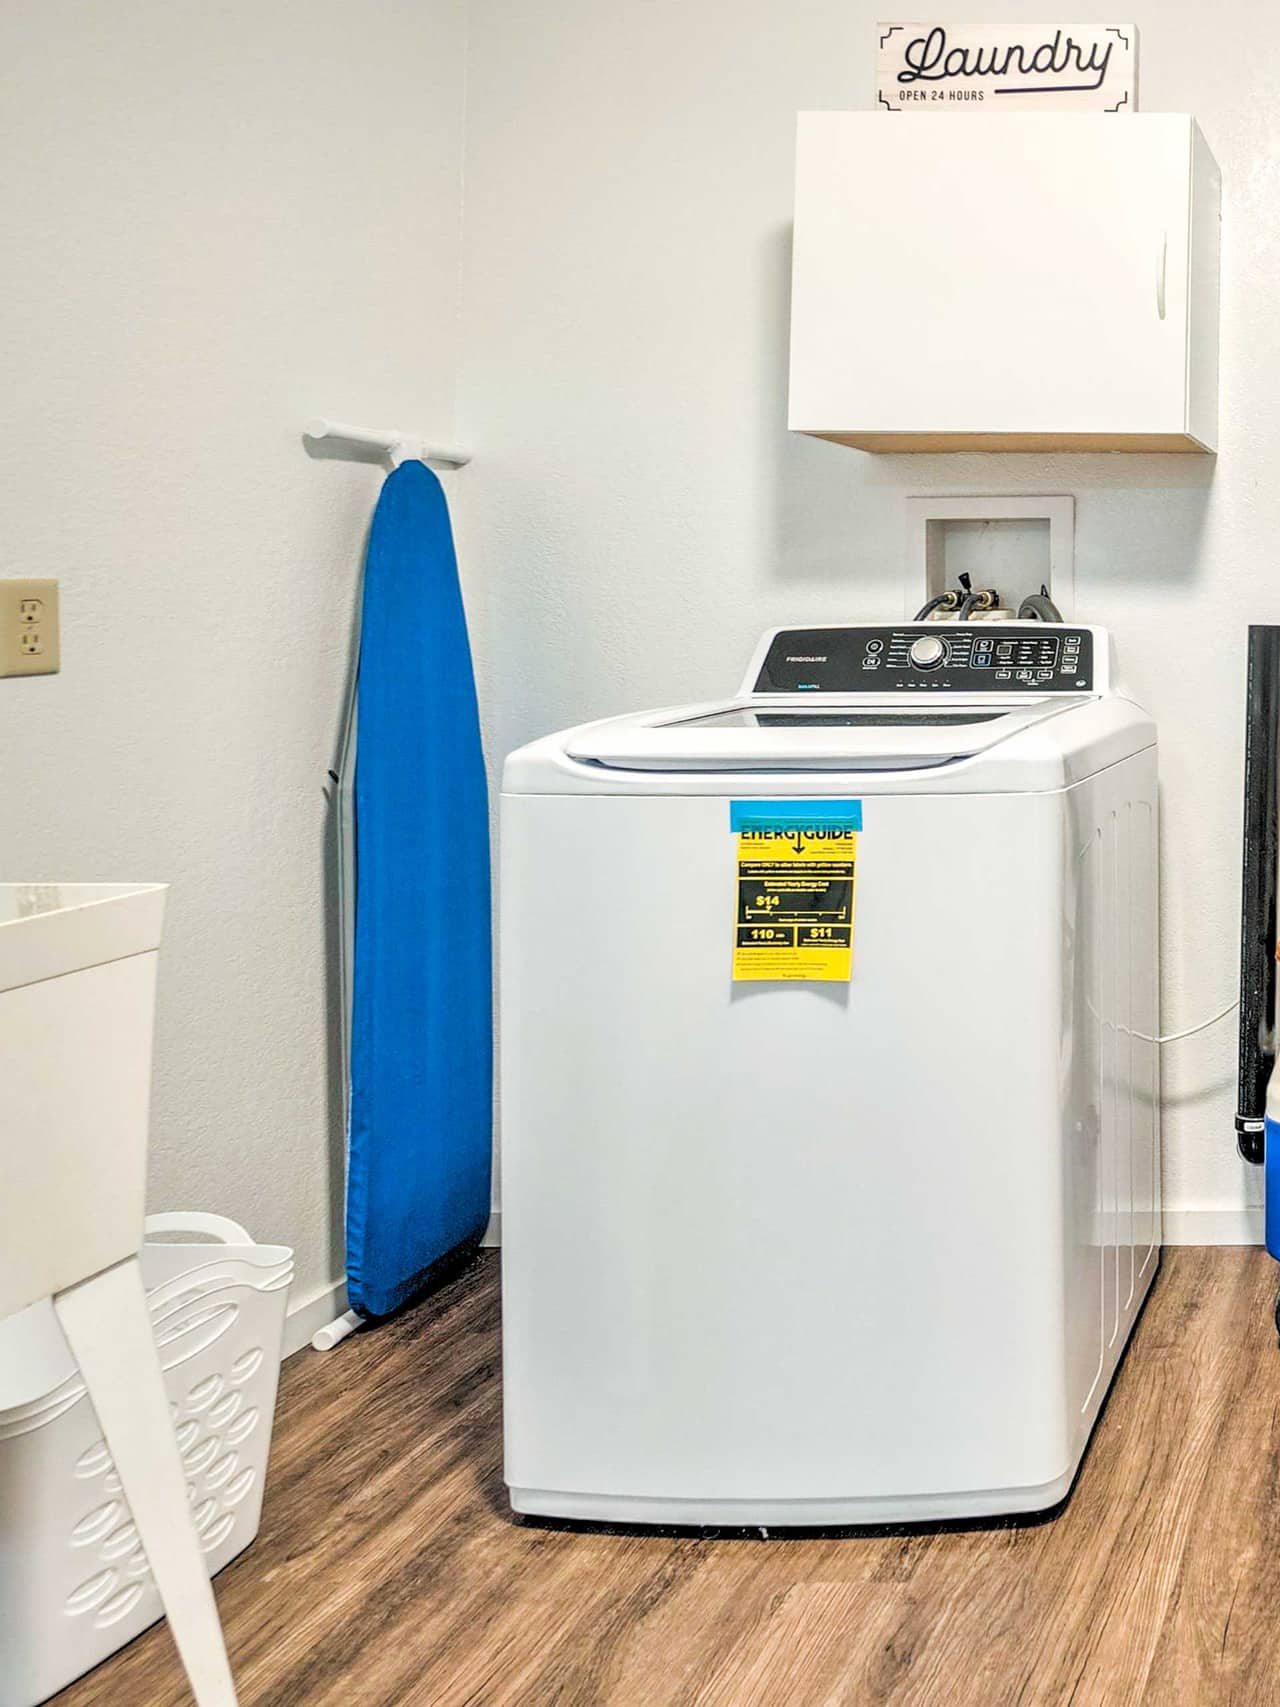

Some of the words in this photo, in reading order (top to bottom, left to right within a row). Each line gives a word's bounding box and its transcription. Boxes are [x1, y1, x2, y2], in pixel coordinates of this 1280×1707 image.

[897, 27, 1113, 94] Laundry
[899, 90, 926, 101] OPEN
[931, 90, 944, 101] 24
[949, 90, 984, 101] HOURS
[752, 929, 774, 939] 110
